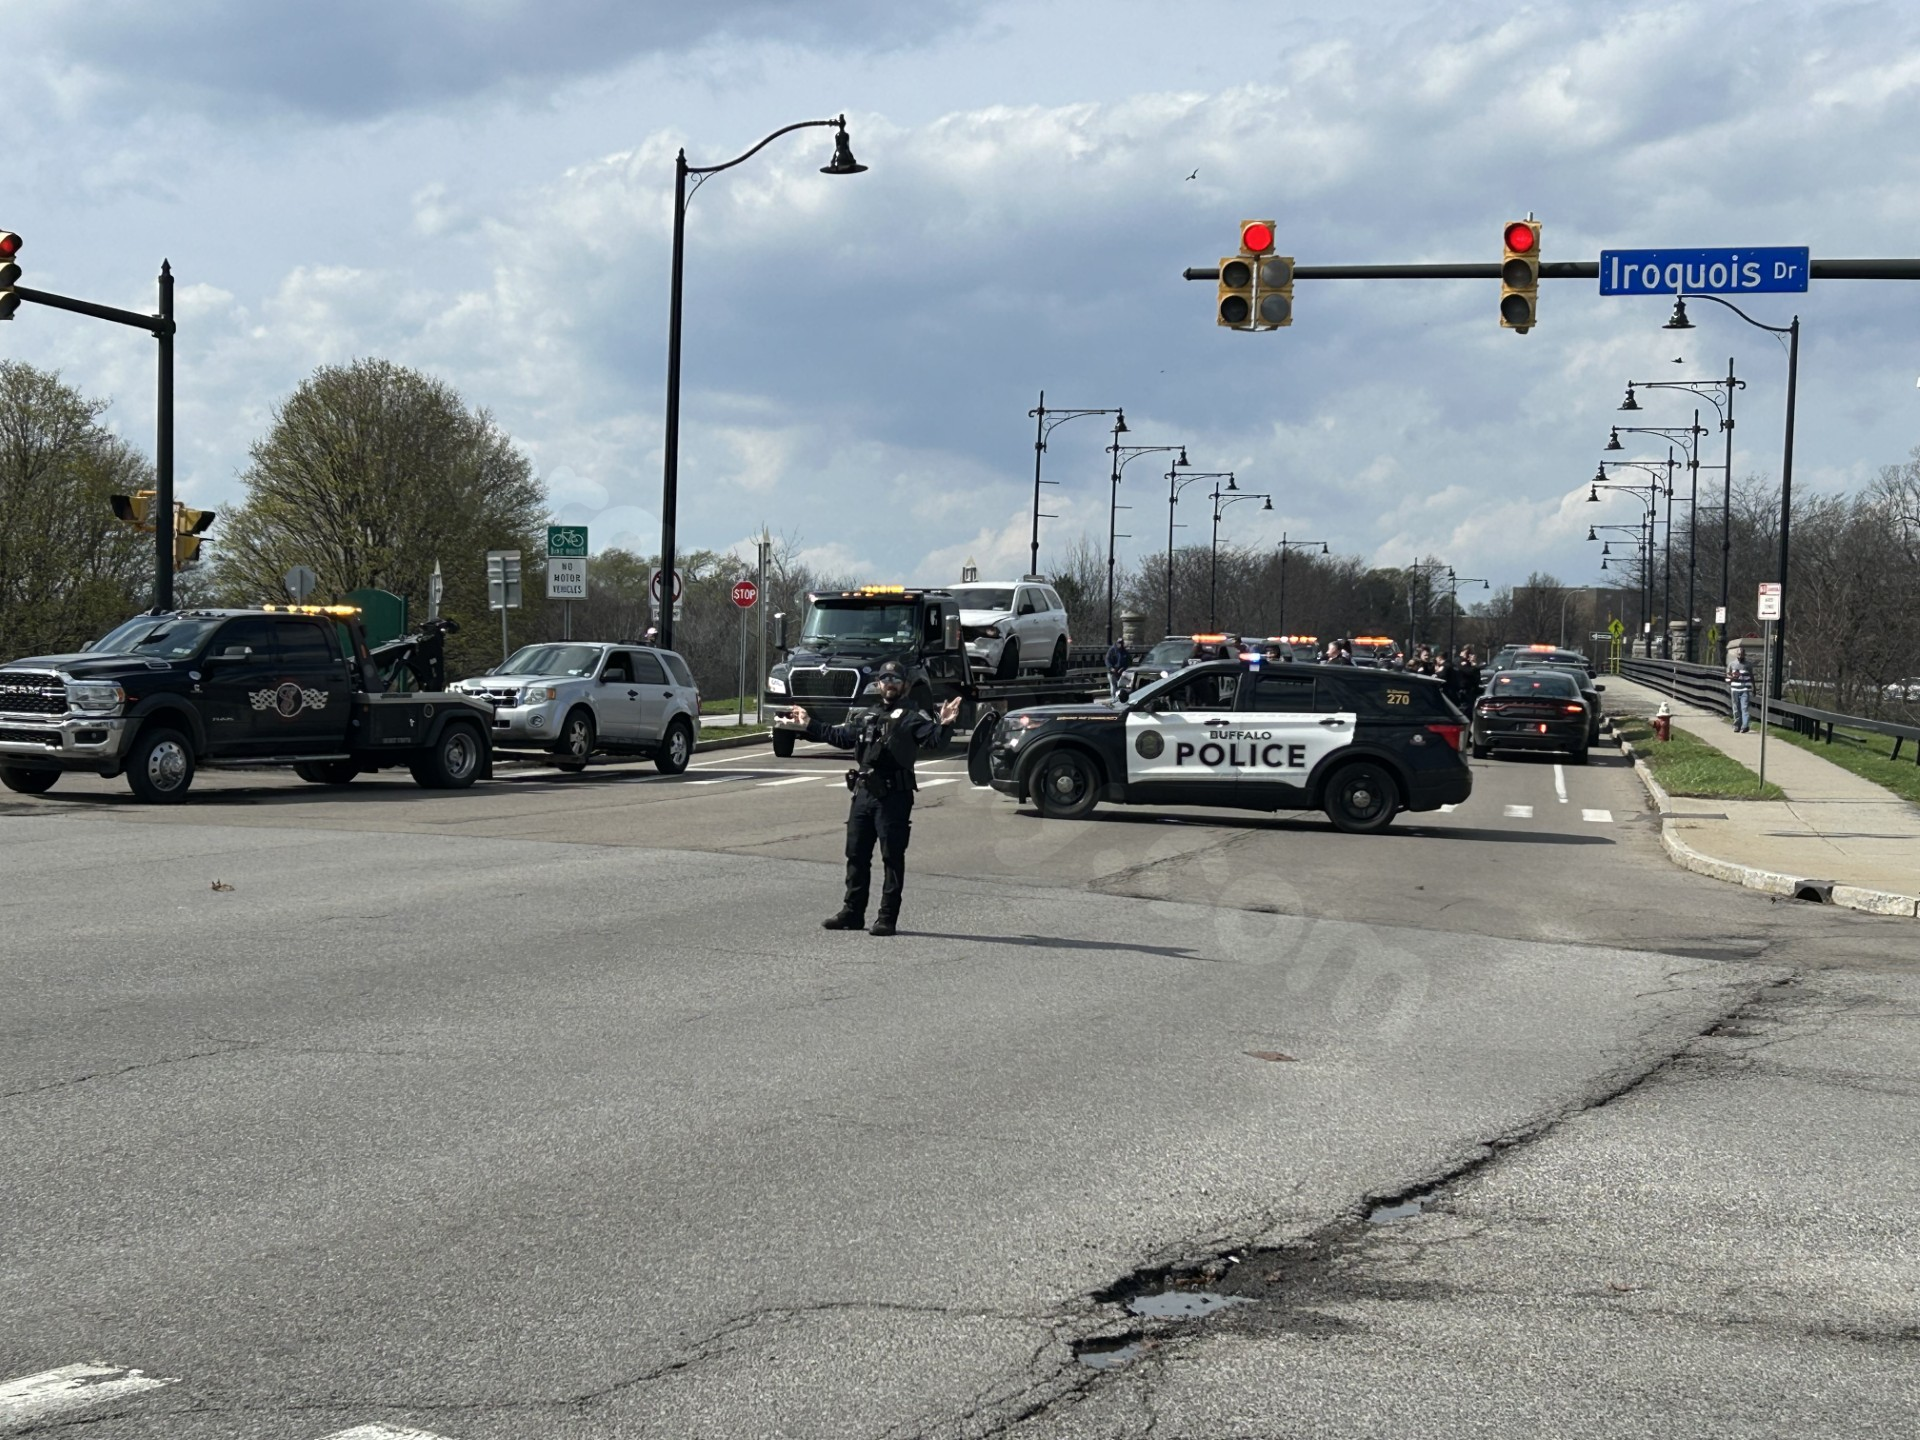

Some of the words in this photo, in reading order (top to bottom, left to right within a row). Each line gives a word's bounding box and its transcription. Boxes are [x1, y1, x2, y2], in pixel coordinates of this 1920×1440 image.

[1611, 255, 1761, 294] Iroquois
[1775, 263, 1797, 279] Dr
[562, 563, 573, 571] NO
[554, 574, 581, 583] MOTOR
[553, 586, 582, 595] VEHICLES
[733, 588, 756, 601] STOP
[1387, 694, 1410, 705] 270
[1209, 729, 1271, 741] BUFFALO
[1177, 742, 1306, 768] POLICE
